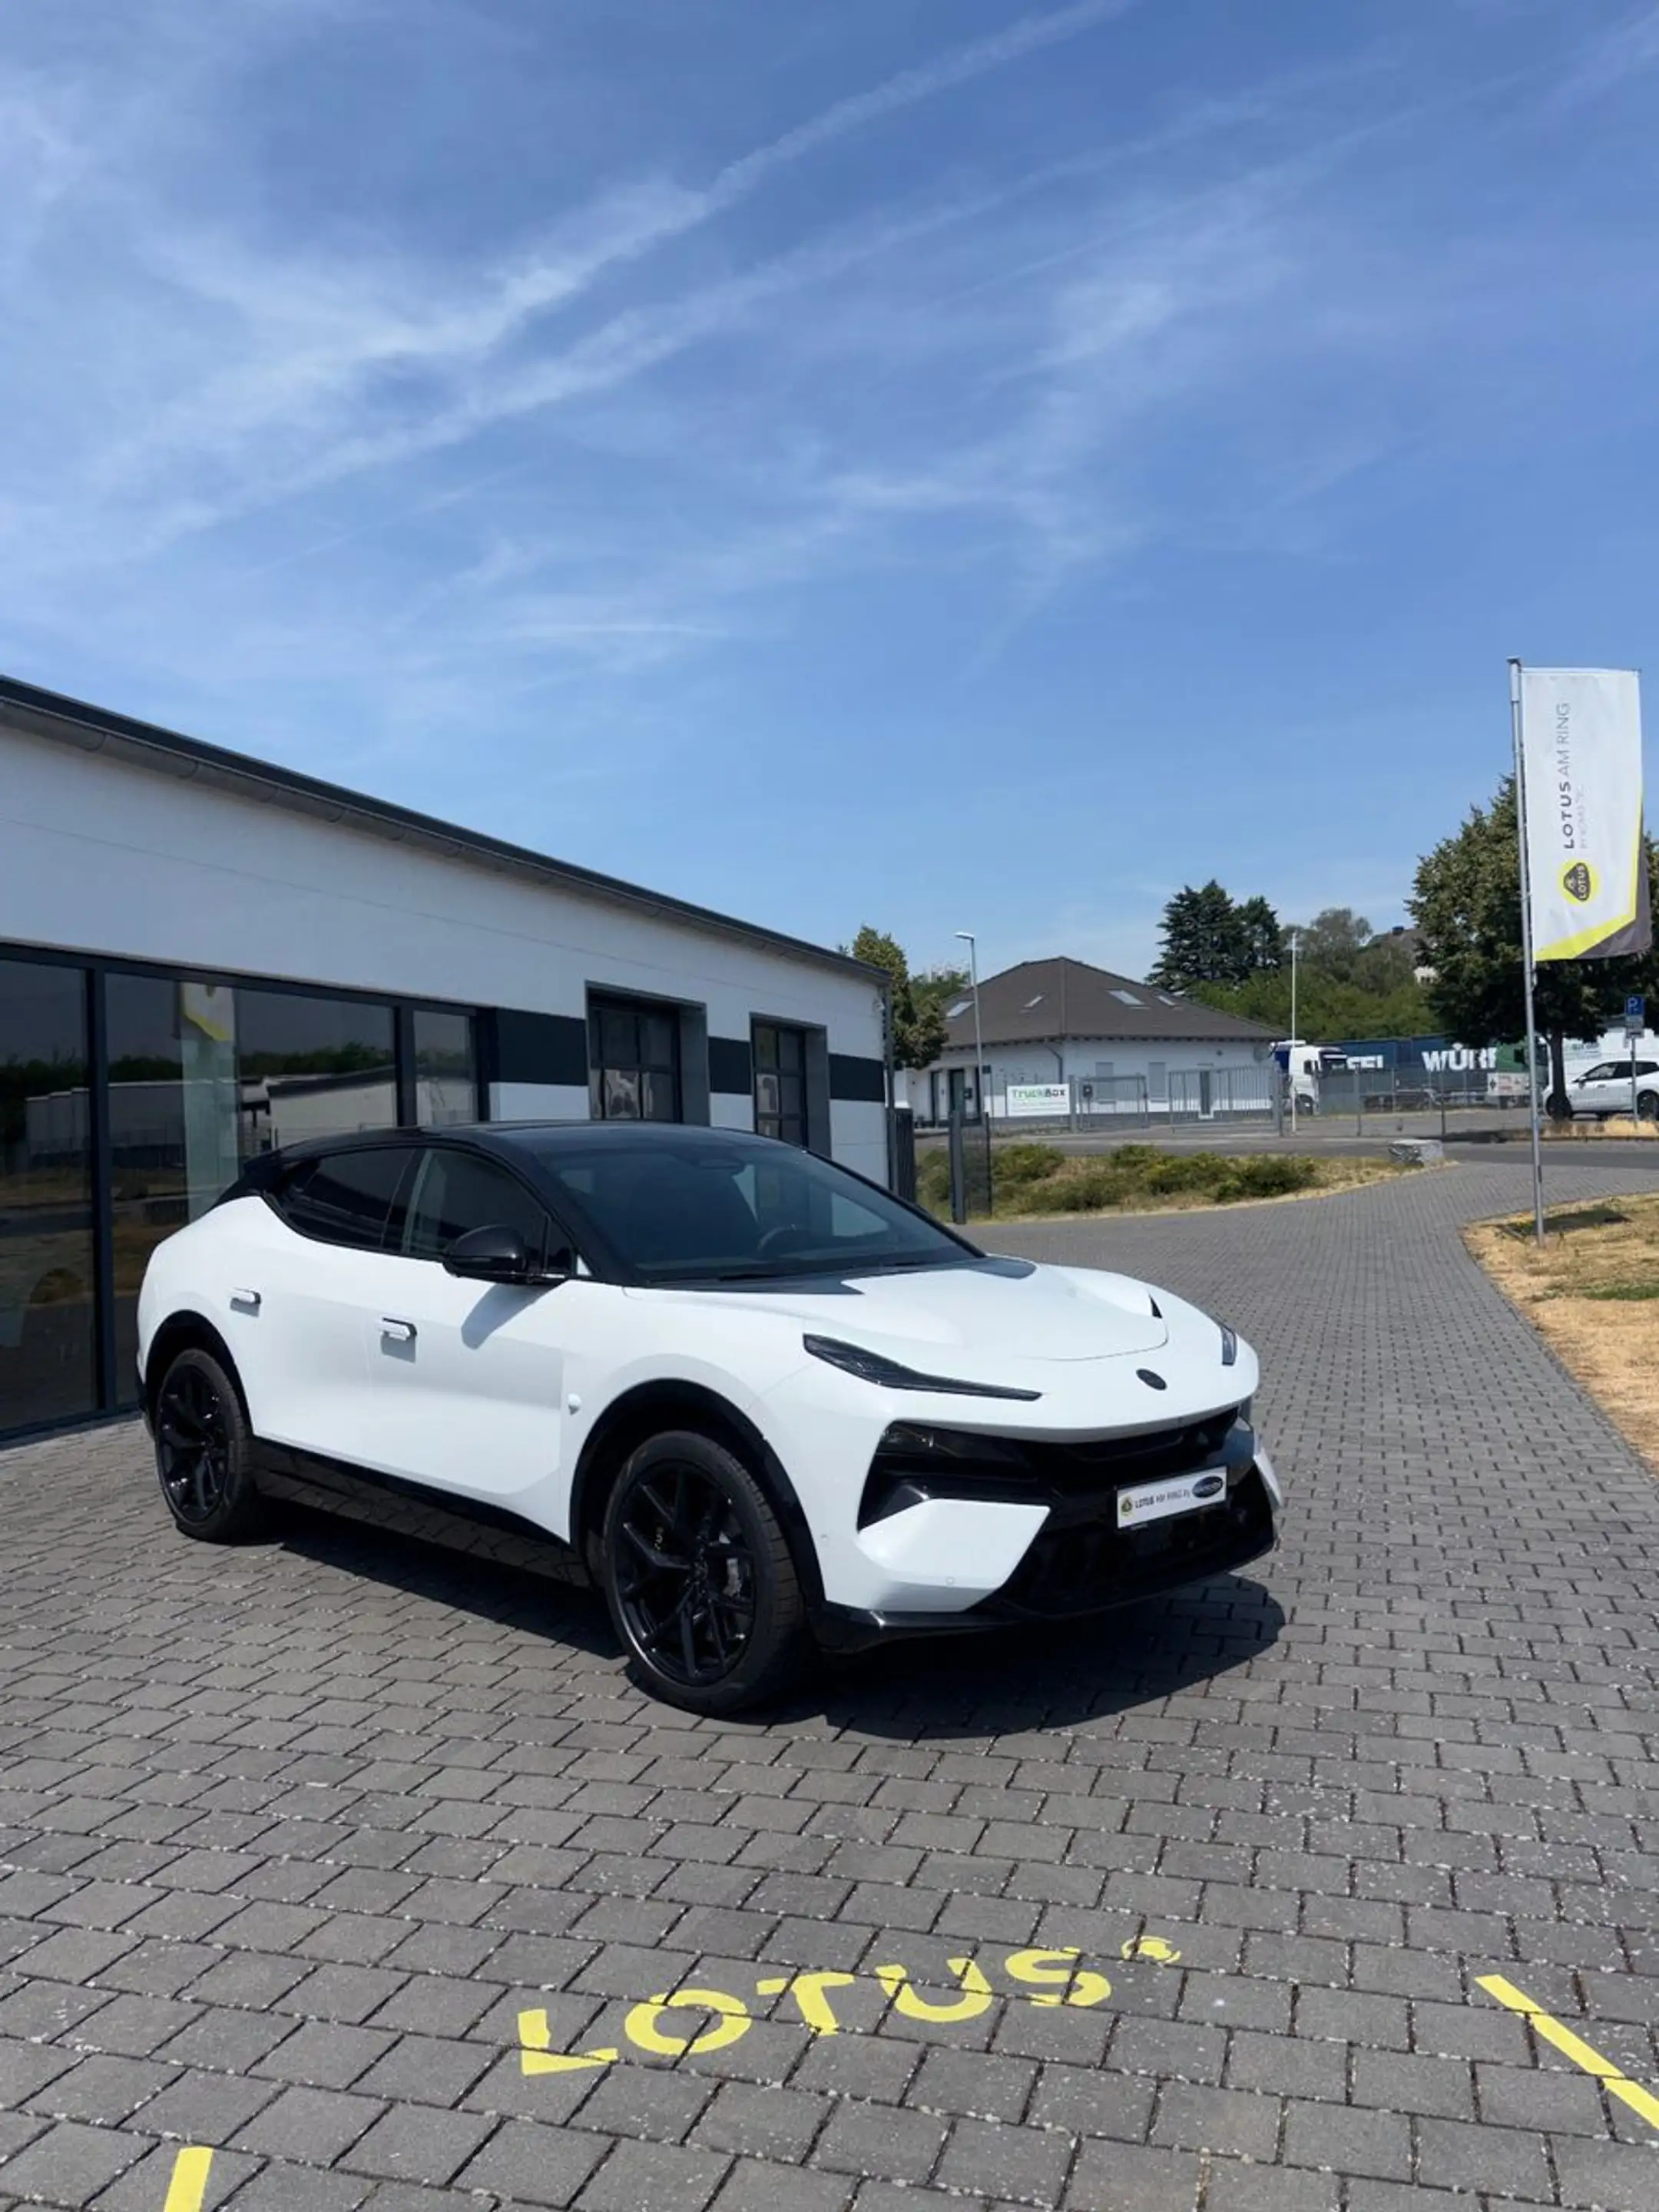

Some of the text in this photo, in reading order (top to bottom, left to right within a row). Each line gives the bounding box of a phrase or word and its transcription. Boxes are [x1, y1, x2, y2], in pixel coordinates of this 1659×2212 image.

[1556, 702, 1575, 849] LOTUS AM RING
[1578, 866, 1590, 900] LOTUS
[1628, 997, 1638, 1015] P
[518, 1946, 1111, 2076] LOTUS
